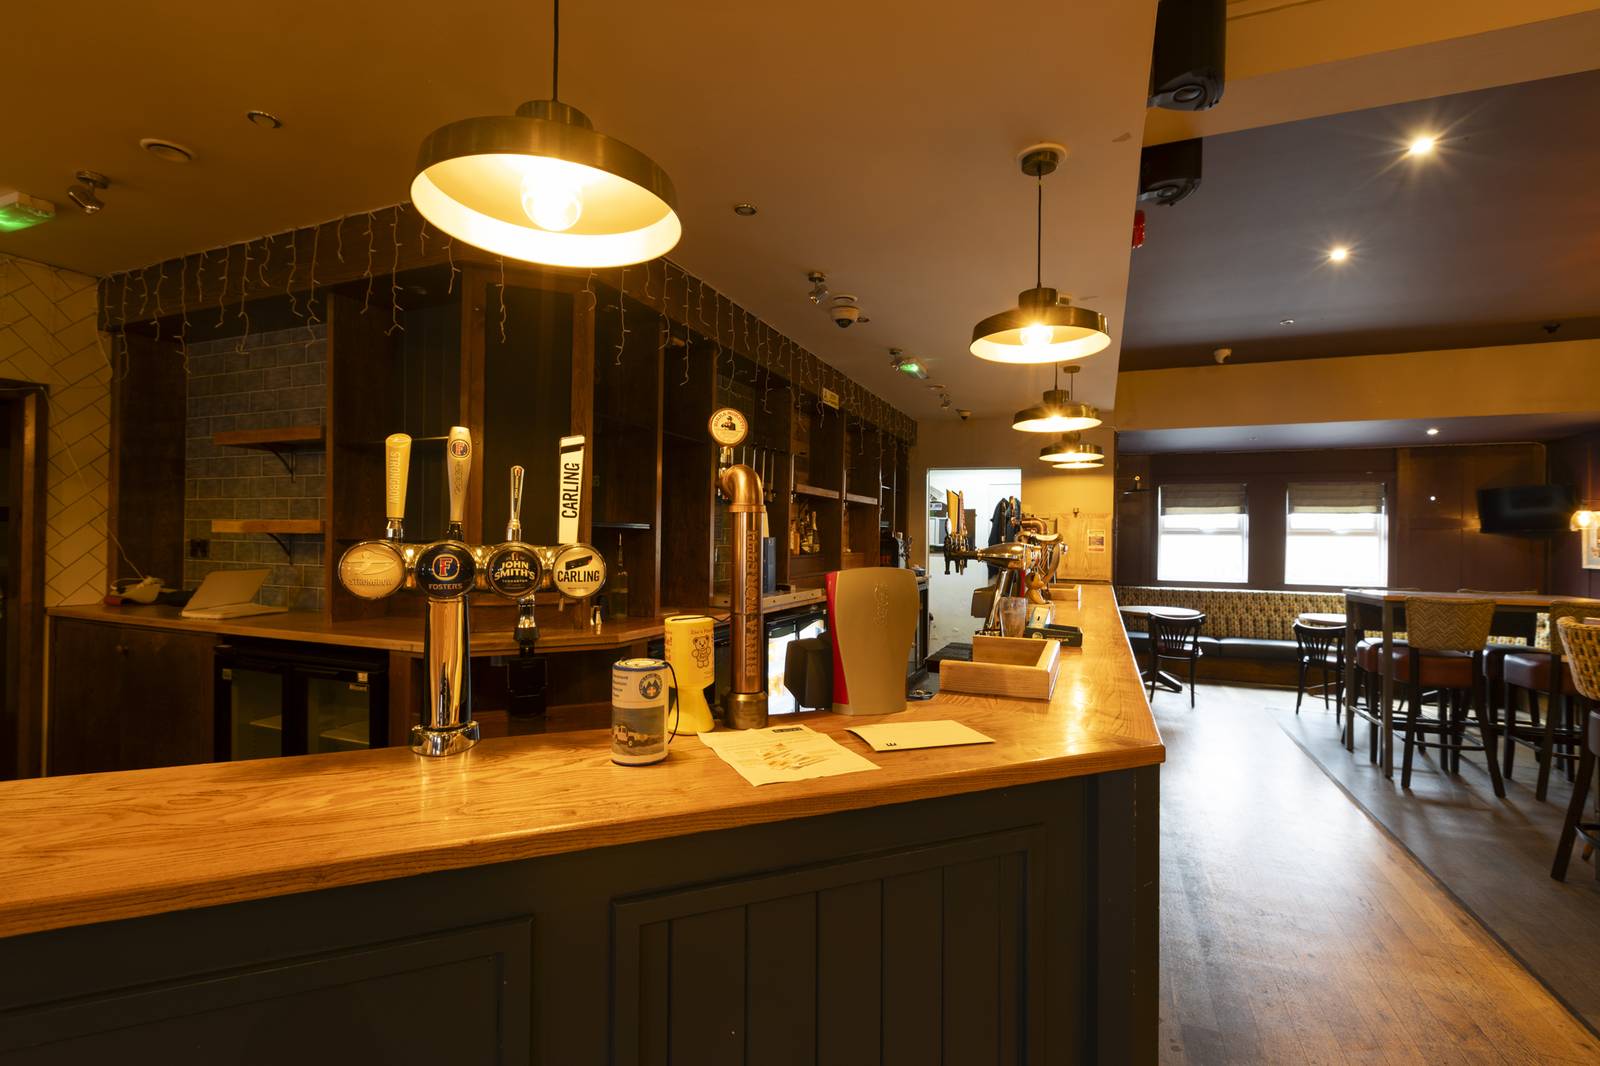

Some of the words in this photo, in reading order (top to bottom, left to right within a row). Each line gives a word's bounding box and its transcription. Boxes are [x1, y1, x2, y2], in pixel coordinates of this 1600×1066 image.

[389, 451, 402, 504] STRONGBOW
[561, 462, 581, 519] CARLING
[439, 557, 453, 577] F
[494, 568, 536, 581] SMITH'S
[501, 560, 529, 570] JOHN
[557, 570, 600, 583] CARLING
[745, 529, 759, 614] MORETTI
[745, 618, 759, 678] BIRRA
